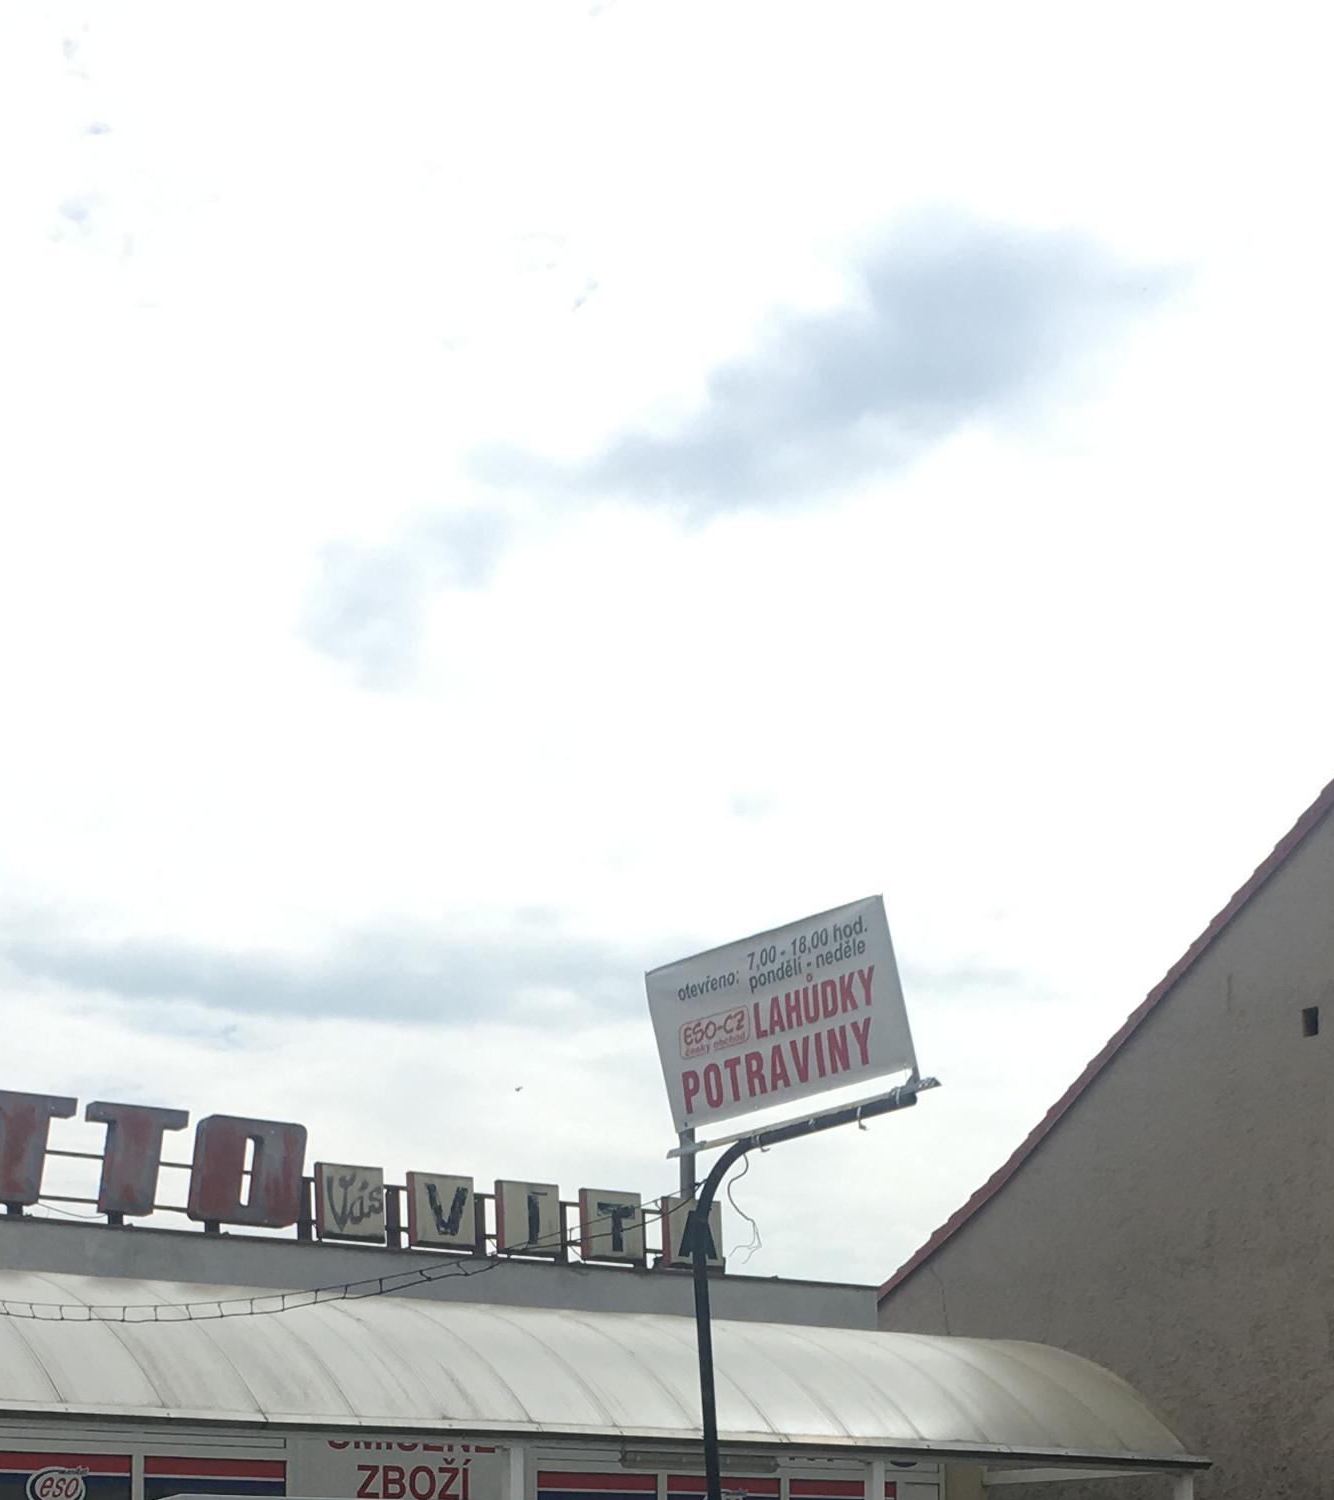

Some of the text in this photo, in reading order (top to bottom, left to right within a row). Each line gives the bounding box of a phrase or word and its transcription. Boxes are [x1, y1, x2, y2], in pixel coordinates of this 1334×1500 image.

[747, 947, 777, 972] 7,00
[790, 928, 829, 958] 18,00
[833, 916, 868, 943] hod.
[749, 955, 803, 994] pondělí
[815, 938, 866, 969] neděle
[677, 970, 740, 1002] otevřeno:
[752, 964, 876, 1040] LAHŮDKY
[683, 1009, 745, 1046] ESO-CZ
[681, 1017, 873, 1115] POTRAVINY
[326, 1171, 384, 1232] Vás
[39, 1476, 79, 1499] eso
[356, 1457, 473, 1500] ZBOŽÍ
